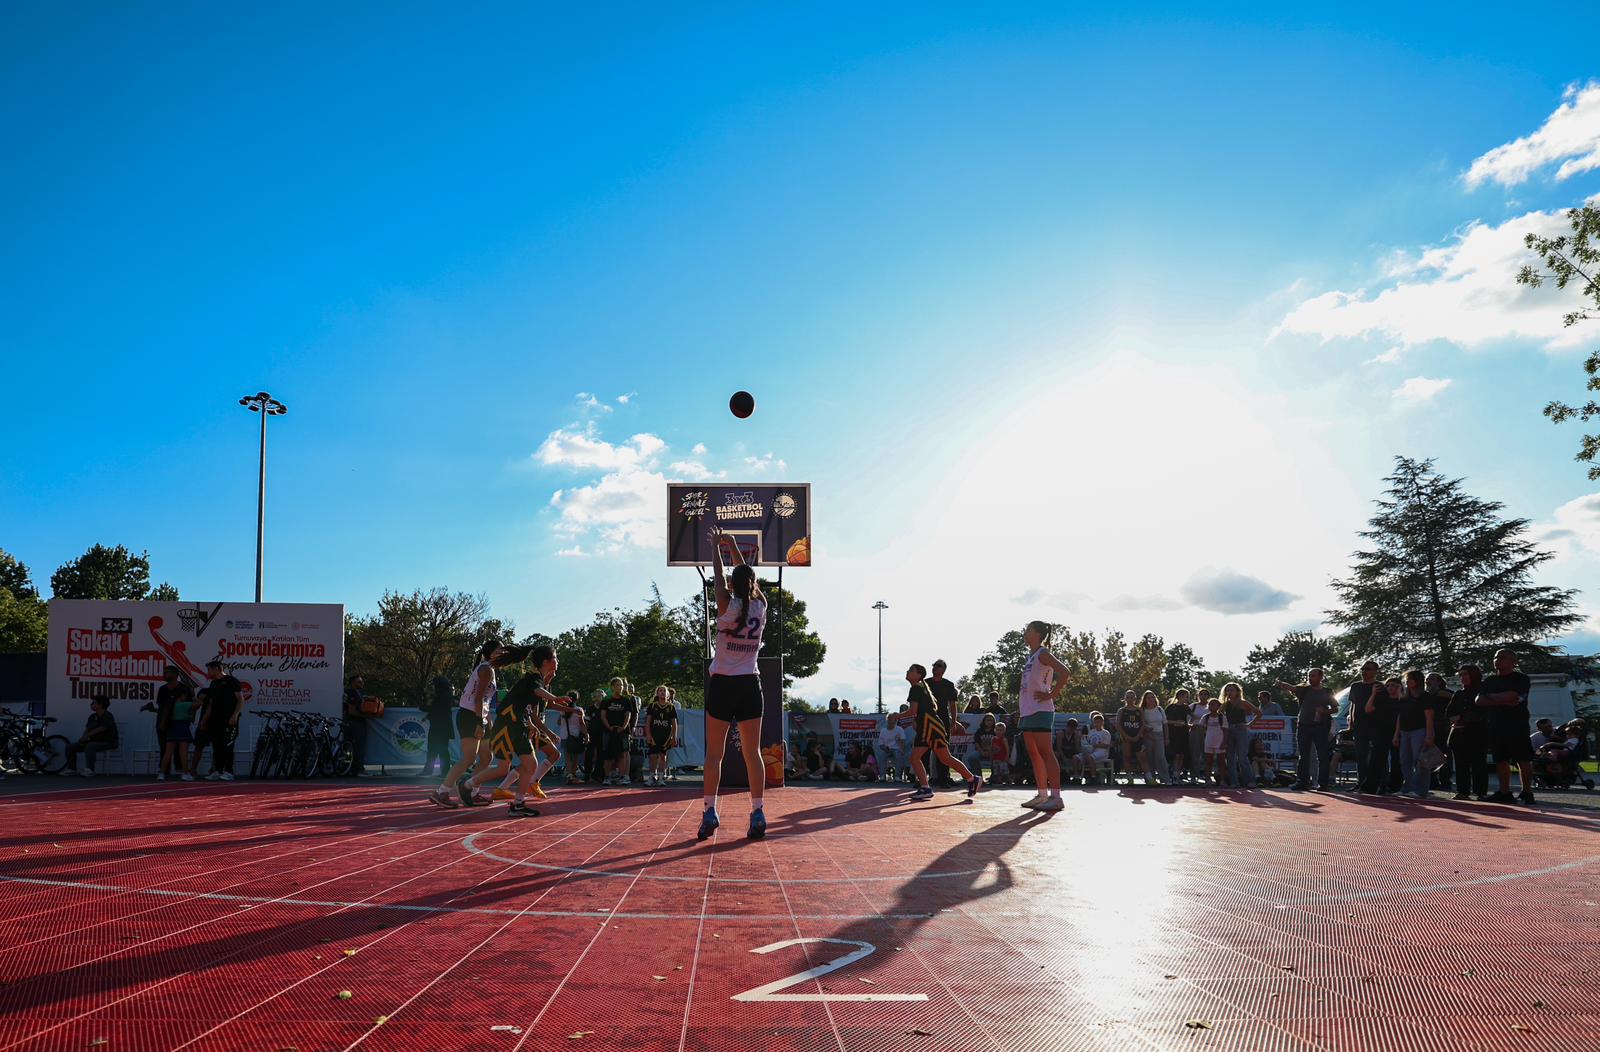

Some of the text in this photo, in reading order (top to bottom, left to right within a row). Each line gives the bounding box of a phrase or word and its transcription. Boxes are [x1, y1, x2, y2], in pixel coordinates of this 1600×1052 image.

[725, 491, 754, 505] 3x3
[716, 503, 763, 513] BASKETBOL
[716, 510, 763, 520] TURNUVASI
[103, 619, 129, 632] 3x3
[70, 629, 122, 652] Sokak
[218, 639, 325, 658] Sporcularımıza
[69, 653, 165, 677] Basketbolu
[278, 655, 330, 673] Dilerim
[70, 677, 154, 700] Turnuvası
[257, 679, 294, 688] YUSUF
[257, 688, 311, 698] ALEMDAR
[653, 719, 669, 727] PMS
[1123, 721, 1140, 729] PMS
[730, 937, 929, 1002] 2
